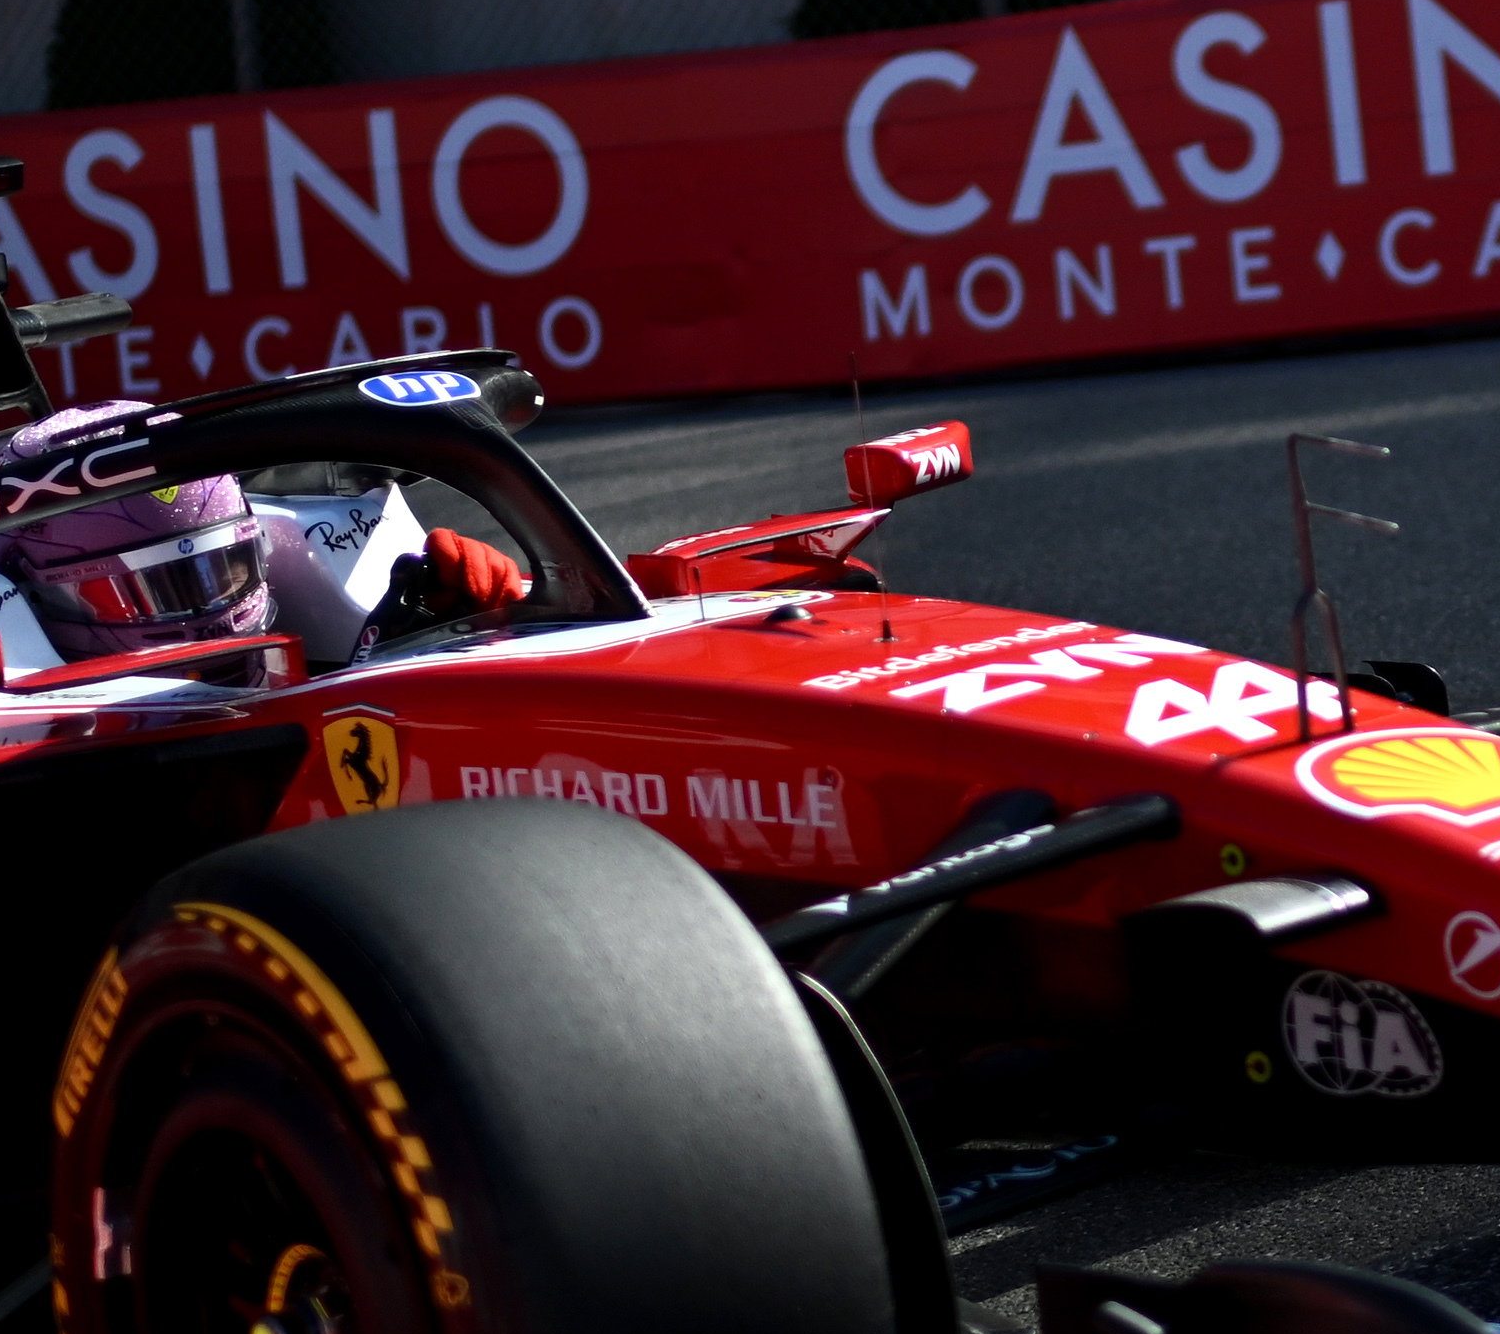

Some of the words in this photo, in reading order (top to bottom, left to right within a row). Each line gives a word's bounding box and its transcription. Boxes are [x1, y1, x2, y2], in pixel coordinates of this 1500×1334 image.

[861, 226, 1282, 341] MONTE
[240, 294, 606, 383] CARLO
[372, 373, 462, 402] hp
[910, 443, 961, 486] ZYN
[304, 509, 389, 552] Ray-Ban
[801, 620, 1102, 690] Bitdefender
[888, 633, 1212, 715] ZYN
[458, 765, 669, 817] RICHARD
[686, 774, 838, 829] MILLE
